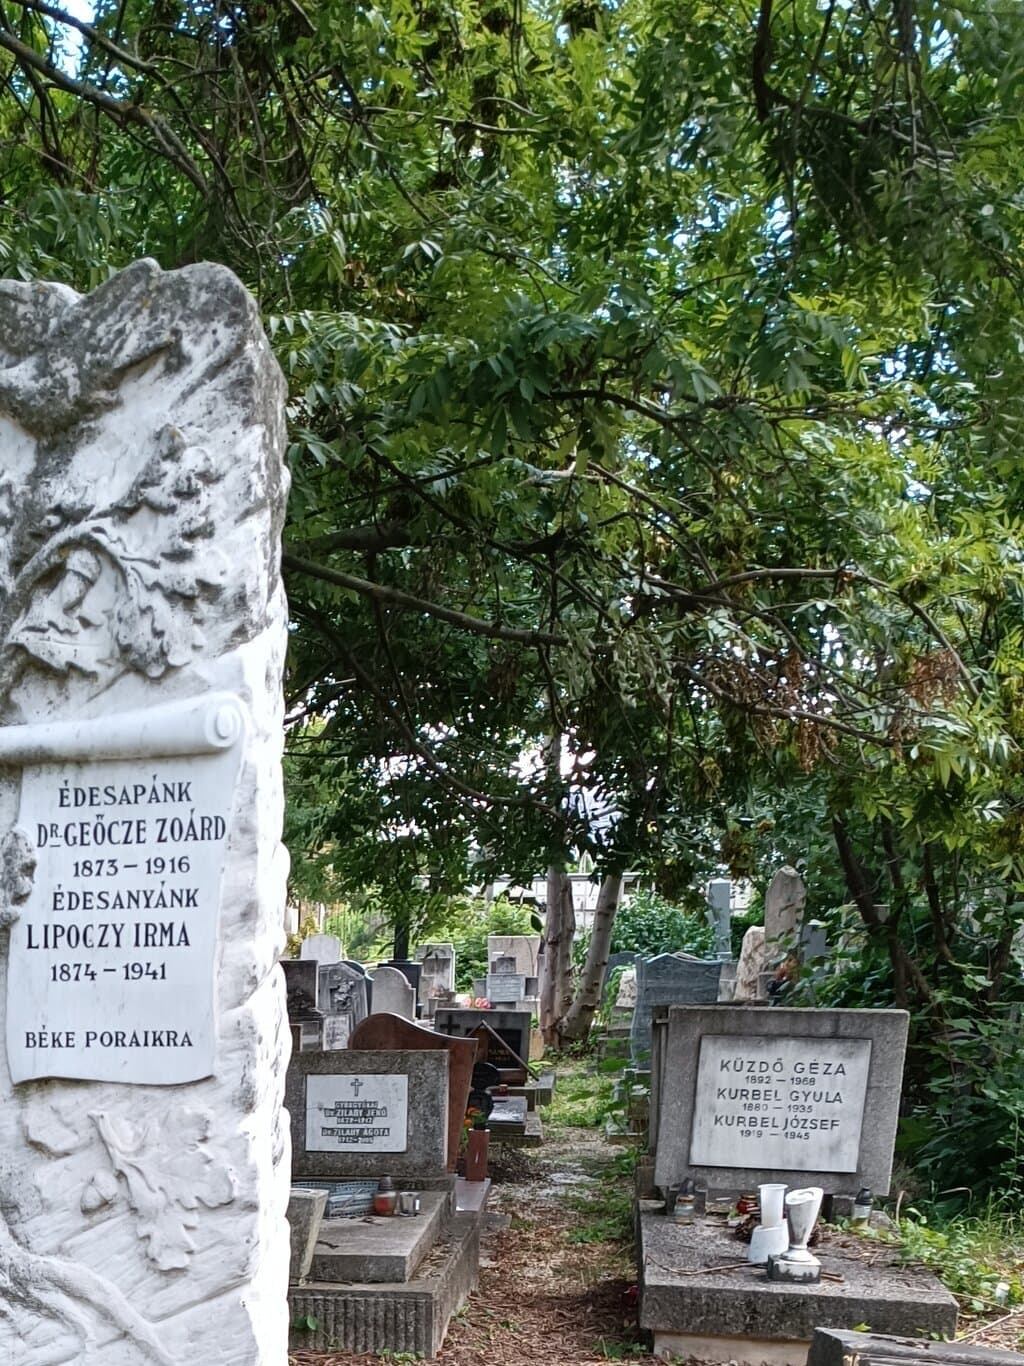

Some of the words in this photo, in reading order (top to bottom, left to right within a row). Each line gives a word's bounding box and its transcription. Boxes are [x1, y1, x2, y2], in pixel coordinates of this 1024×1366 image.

[58, 773, 193, 808] ÉDESAPÁNK
[156, 808, 226, 843] ZOÁRD
[73, 860, 119, 878] 1873
[145, 856, 191, 875] 1916
[52, 880, 200, 912] ÉDESANYÁNK
[26, 923, 125, 950] LIPOCZY
[134, 921, 191, 948] IRMA
[51, 963, 98, 982] 1874
[124, 962, 167, 981] 1941
[25, 1025, 76, 1049] BÉKE
[85, 1030, 193, 1048] PORAIKRA
[794, 1059, 846, 1076] GÉZA
[745, 1075, 772, 1084] 1892
[790, 1077, 816, 1086] 1968
[717, 1088, 782, 1101] KURBEL
[789, 1090, 843, 1103] GYULA
[743, 1103, 768, 1111] 1880
[788, 1104, 813, 1113] 1935
[714, 1115, 779, 1128] KURBEL
[782, 1115, 840, 1131] JÓZSEF
[784, 1131, 810, 1141] 1945
